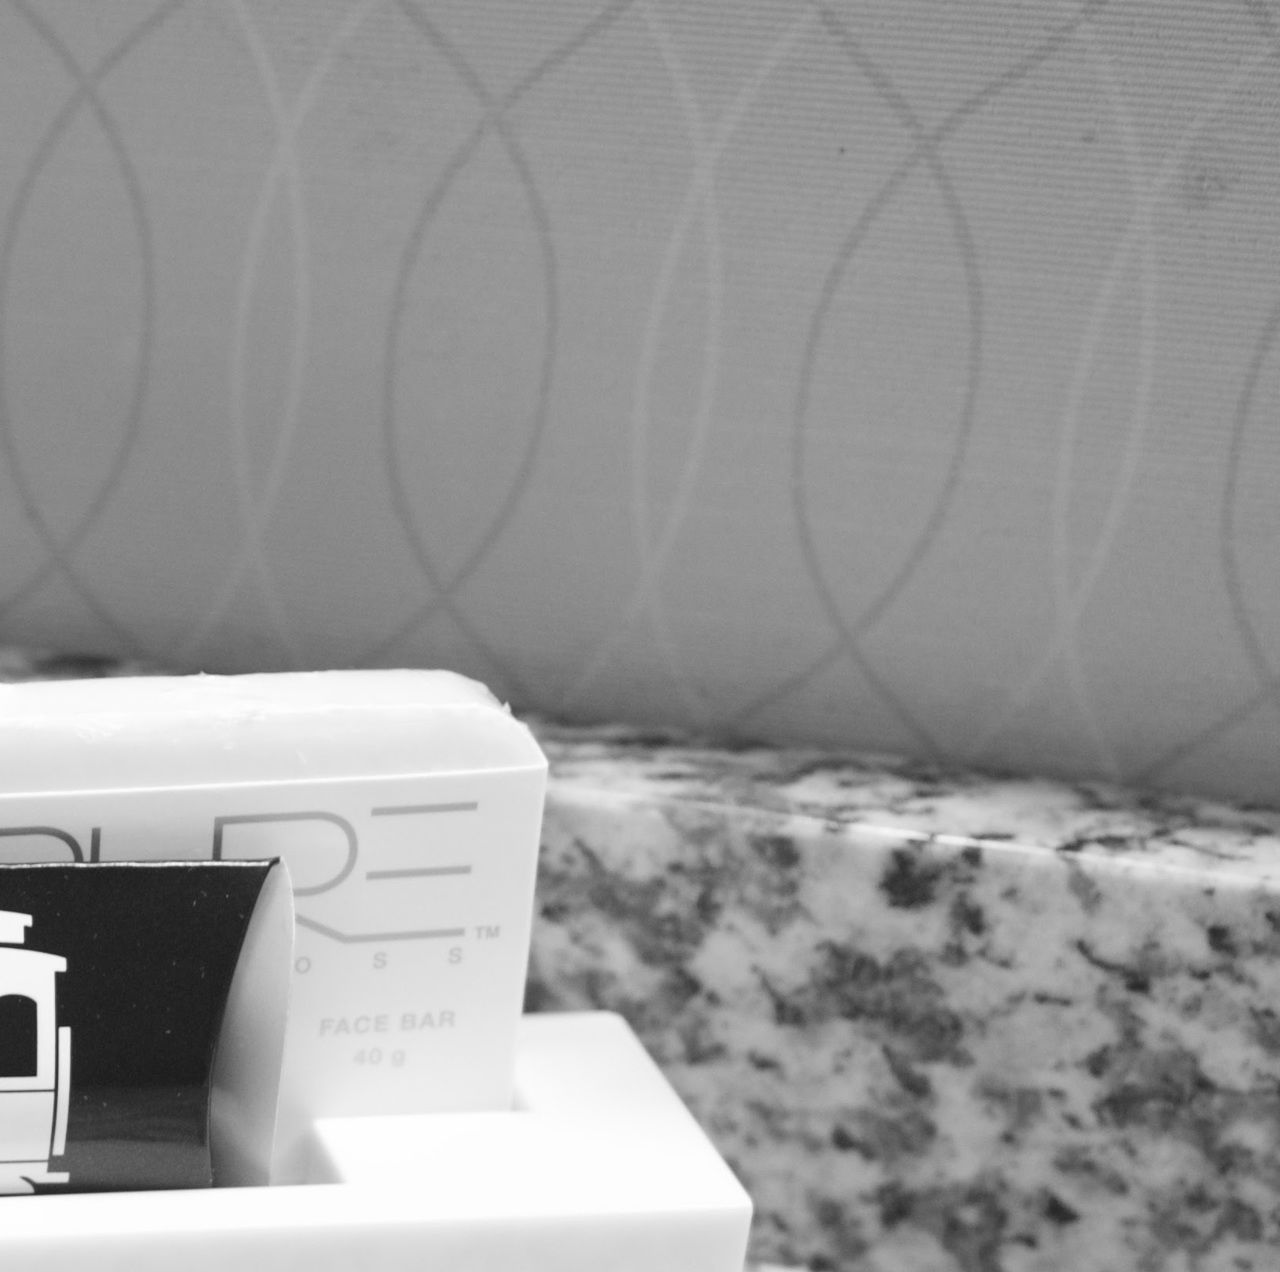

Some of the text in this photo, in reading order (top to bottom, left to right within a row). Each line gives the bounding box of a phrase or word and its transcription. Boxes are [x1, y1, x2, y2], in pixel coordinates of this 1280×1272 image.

[318, 1010, 456, 1038] FACE BAR
[352, 1047, 407, 1067] 40 g
